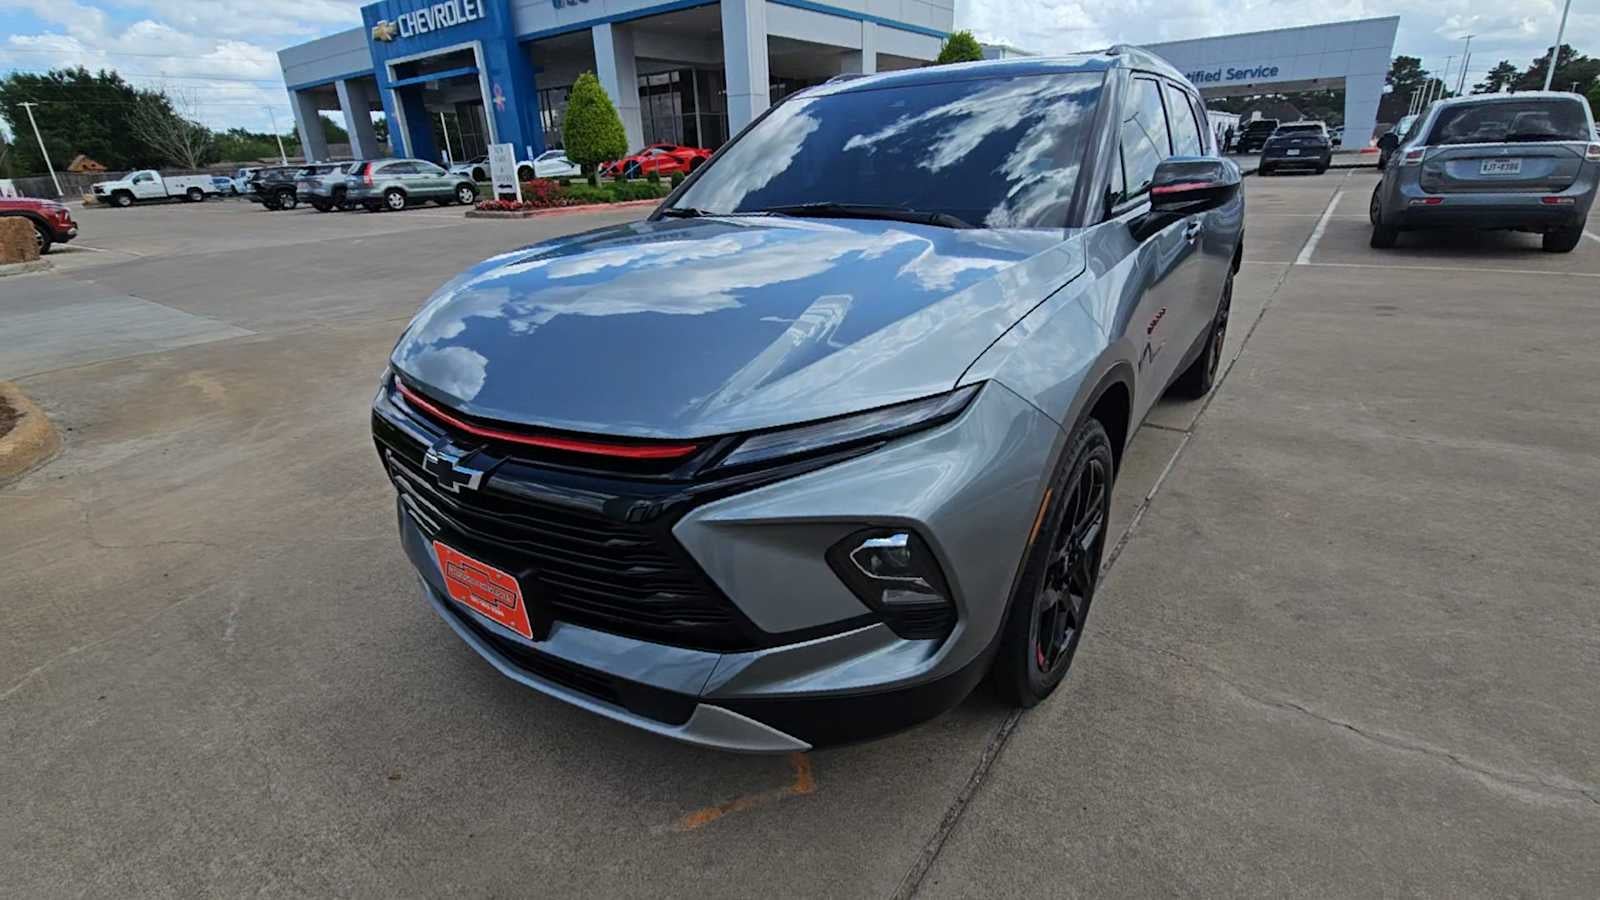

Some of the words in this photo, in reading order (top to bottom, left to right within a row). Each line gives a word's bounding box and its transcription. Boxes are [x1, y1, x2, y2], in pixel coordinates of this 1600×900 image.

[398, 0, 485, 37] CHEVROLET
[1185, 68, 1222, 83] tified
[1226, 65, 1279, 81] Service
